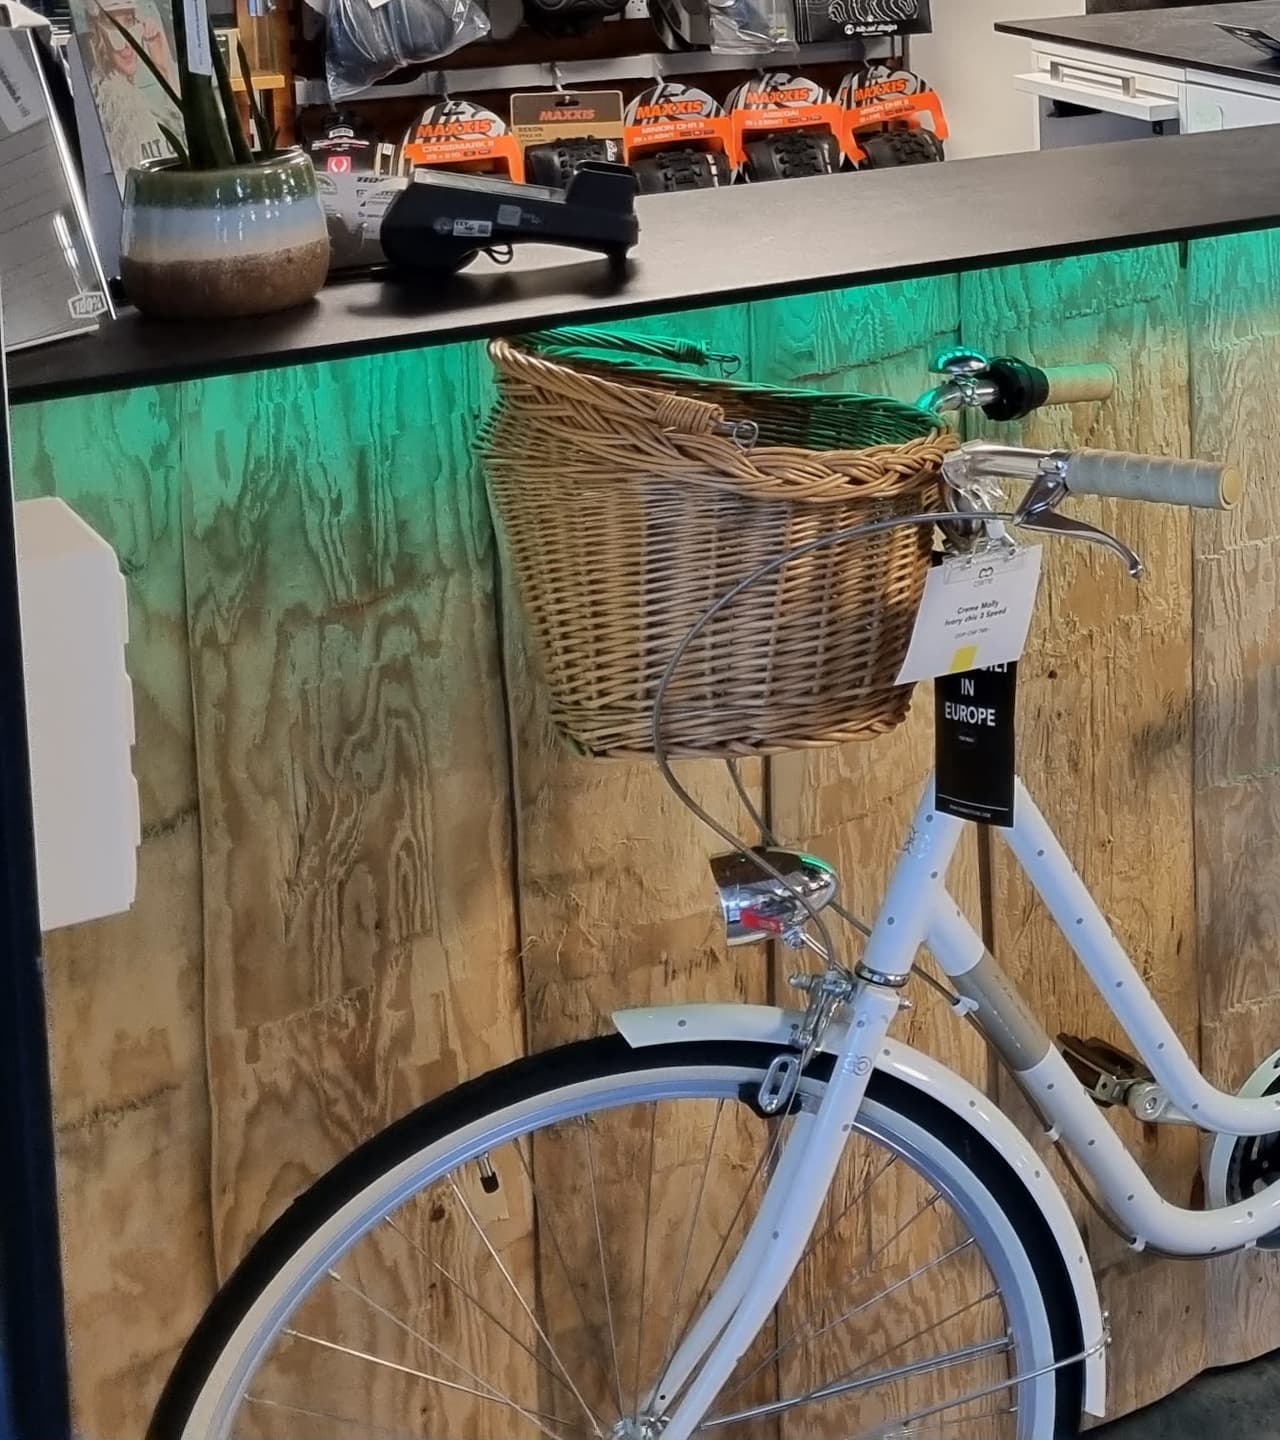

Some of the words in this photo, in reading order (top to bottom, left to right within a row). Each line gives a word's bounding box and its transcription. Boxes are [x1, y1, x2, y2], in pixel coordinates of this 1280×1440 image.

[746, 87, 812, 104] MAXXIS
[854, 78, 908, 101] MAXXIS
[539, 109, 596, 121] MAXXIS
[636, 100, 706, 120] MAXXIS
[416, 119, 493, 138] MAXXIS
[960, 677, 975, 697] IN
[944, 701, 996, 727] EUROPE
